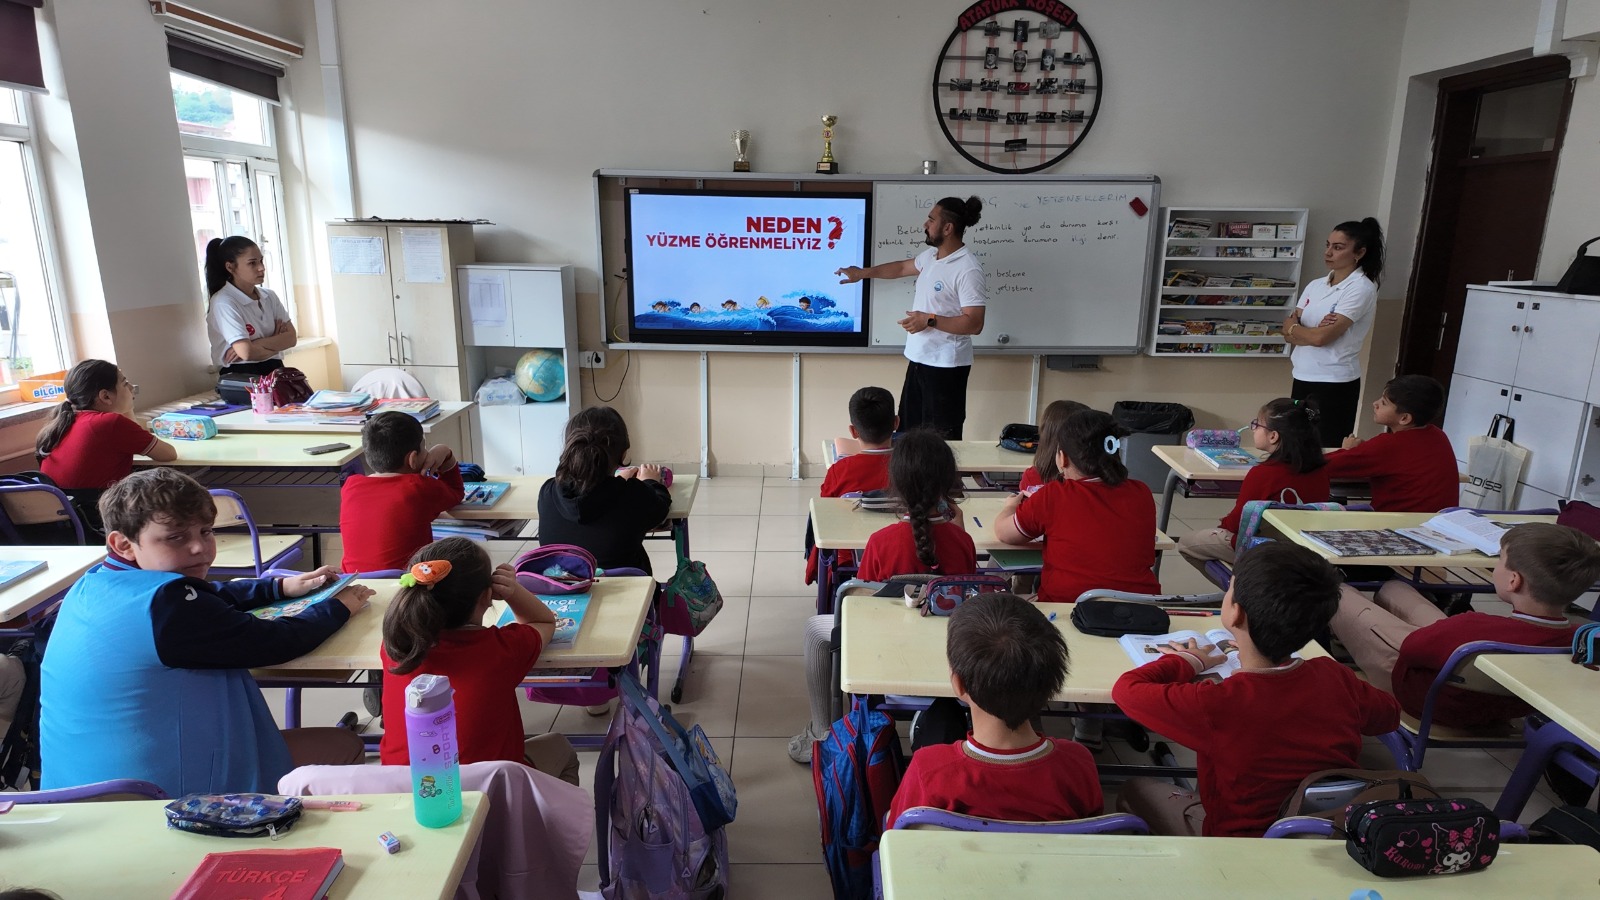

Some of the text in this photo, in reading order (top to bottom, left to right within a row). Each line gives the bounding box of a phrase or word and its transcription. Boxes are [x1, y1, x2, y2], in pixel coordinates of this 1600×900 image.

[746, 216, 822, 234] NEDEN
[646, 232, 701, 248] YÜZME
[556, 604, 569, 613] 4
[441, 724, 453, 770] SPORT
[215, 867, 308, 884] TÜRKÇE
